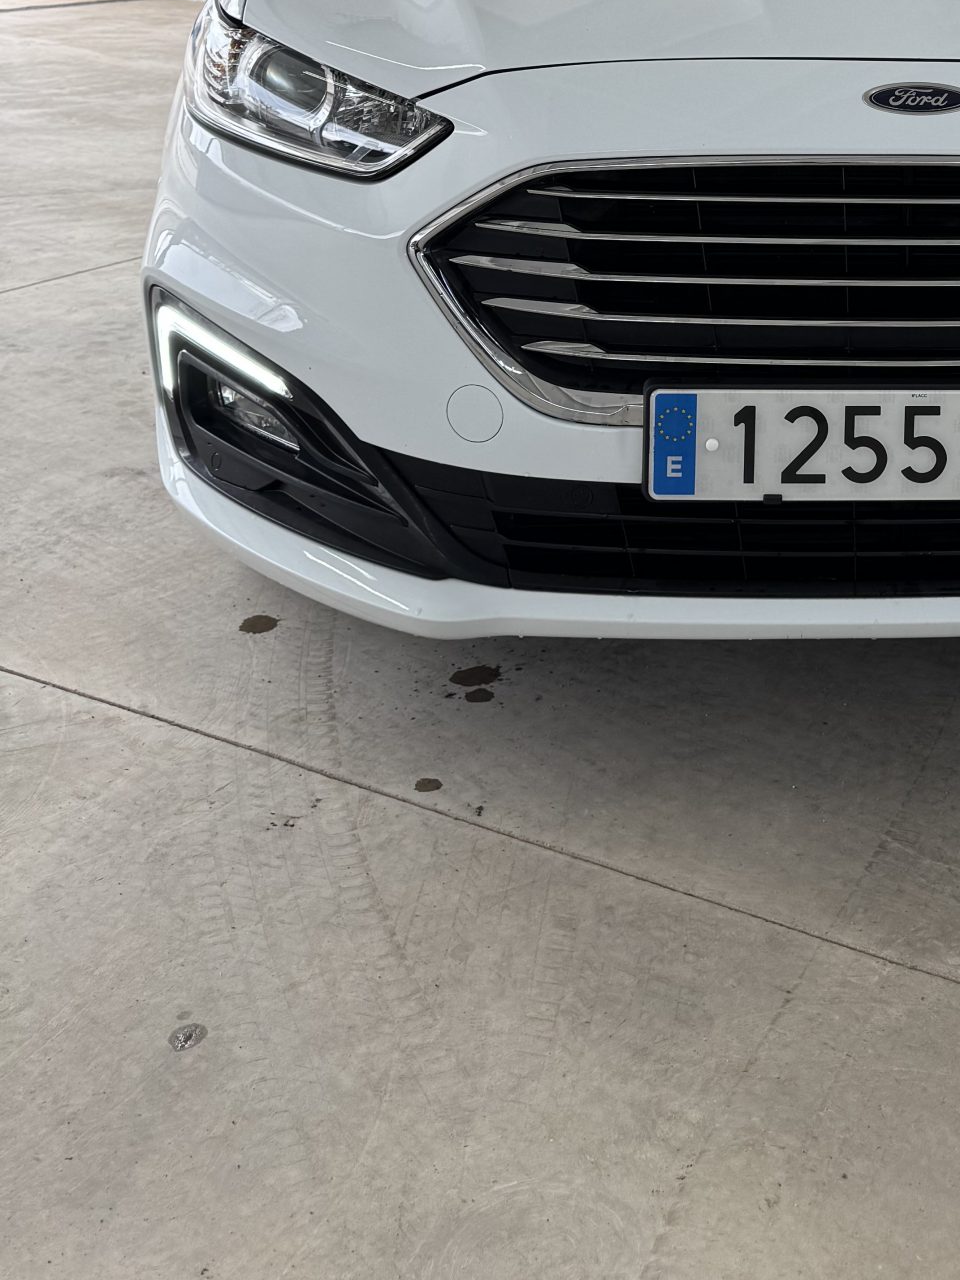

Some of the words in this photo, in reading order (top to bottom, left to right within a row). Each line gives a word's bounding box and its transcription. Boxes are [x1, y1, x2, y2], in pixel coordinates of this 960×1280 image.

[888, 87, 949, 107] Ford
[666, 456, 682, 478] E
[733, 405, 948, 484] 1255
